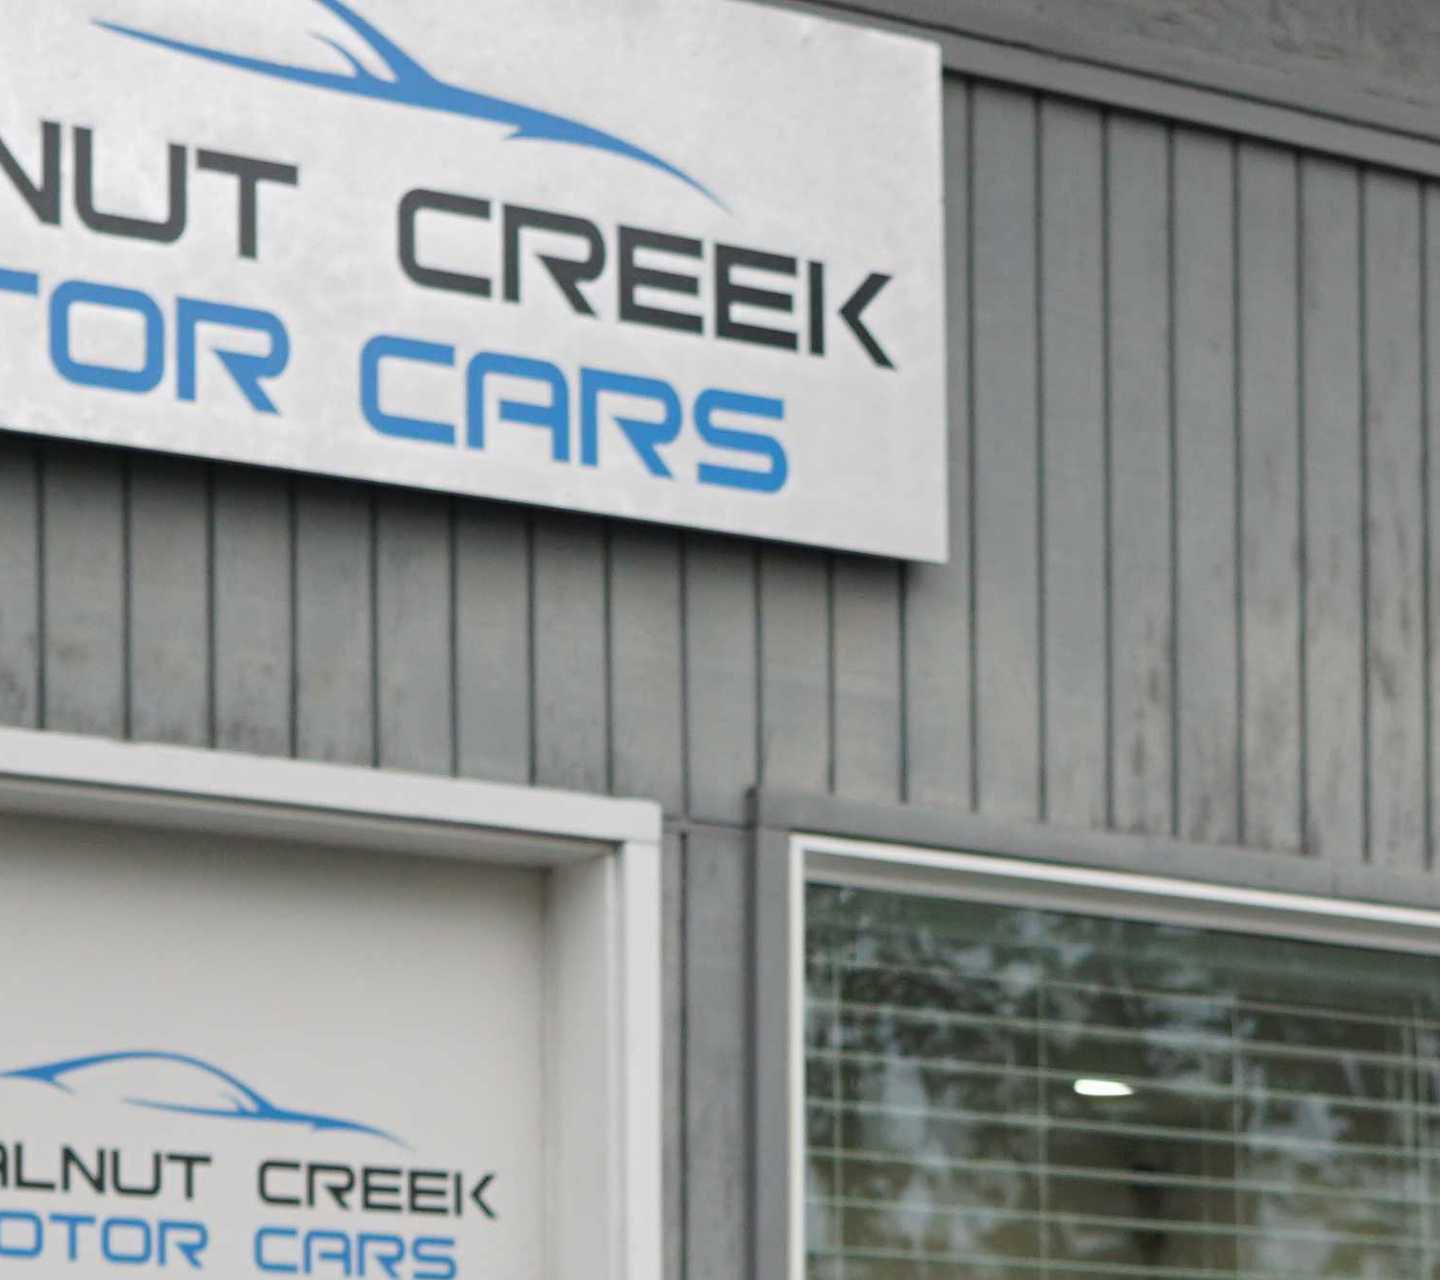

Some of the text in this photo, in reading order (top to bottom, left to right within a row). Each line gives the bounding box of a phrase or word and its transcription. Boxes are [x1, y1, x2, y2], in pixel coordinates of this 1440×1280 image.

[396, 187, 898, 371] CREEK
[358, 333, 791, 495] CARS
[256, 1157, 499, 1221] CREEK
